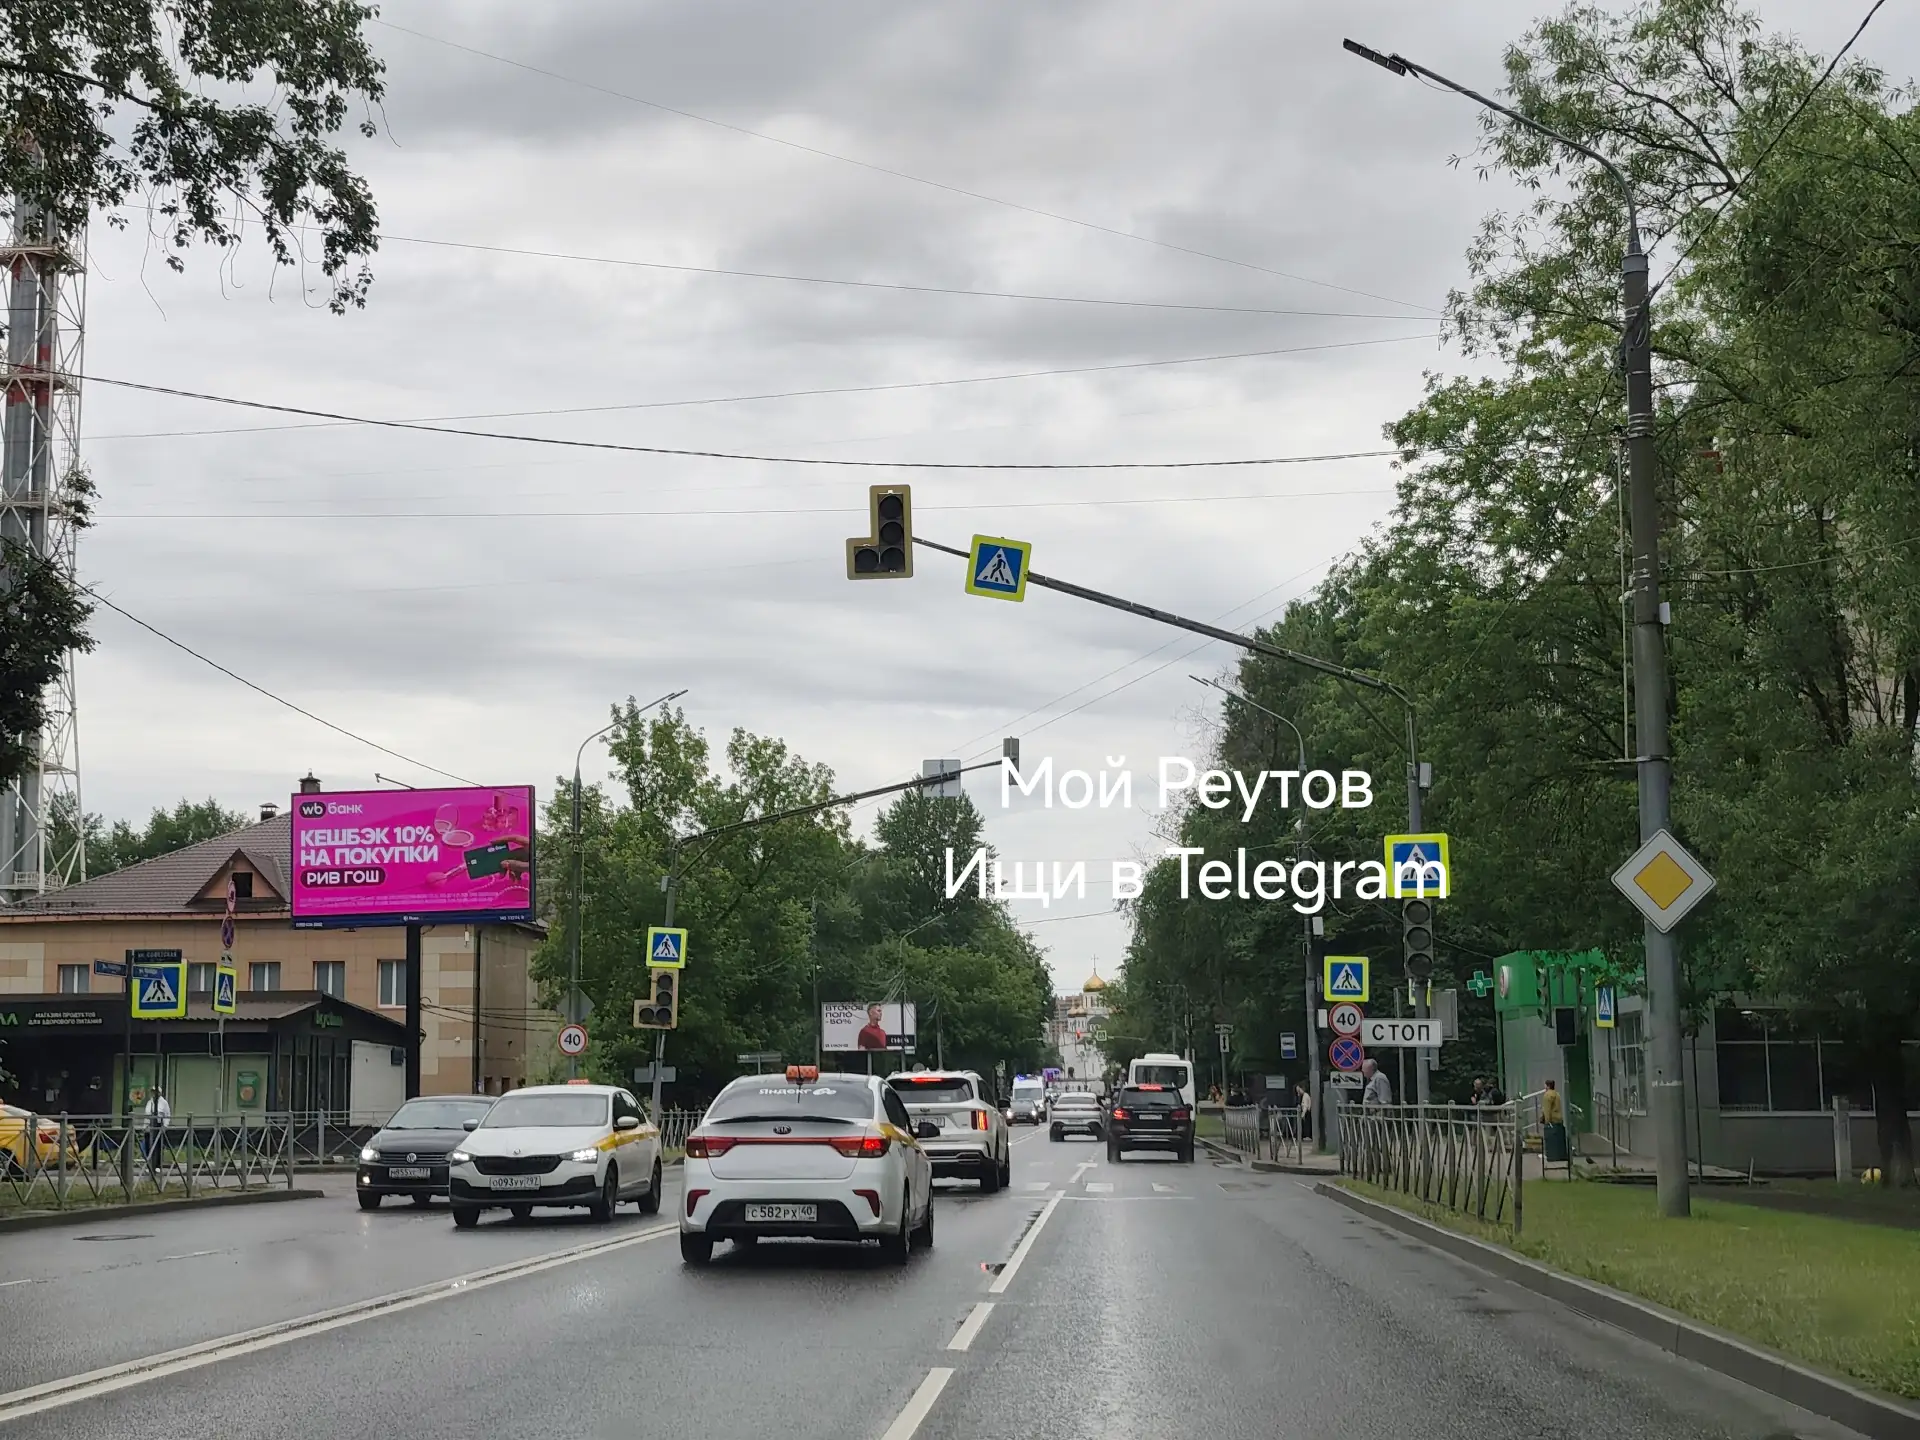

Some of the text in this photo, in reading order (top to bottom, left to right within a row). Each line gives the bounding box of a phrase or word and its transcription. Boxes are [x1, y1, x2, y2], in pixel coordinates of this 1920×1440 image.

[302, 801, 363, 815] wb банк
[300, 825, 435, 847] КЕШБЭК 10%
[300, 845, 438, 866] НА ПОКУПКИ
[306, 869, 379, 885] РИВ ГОШ
[1336, 1012, 1356, 1026] 40
[564, 1033, 581, 1046] 40
[1371, 1023, 1430, 1042] СТОП
